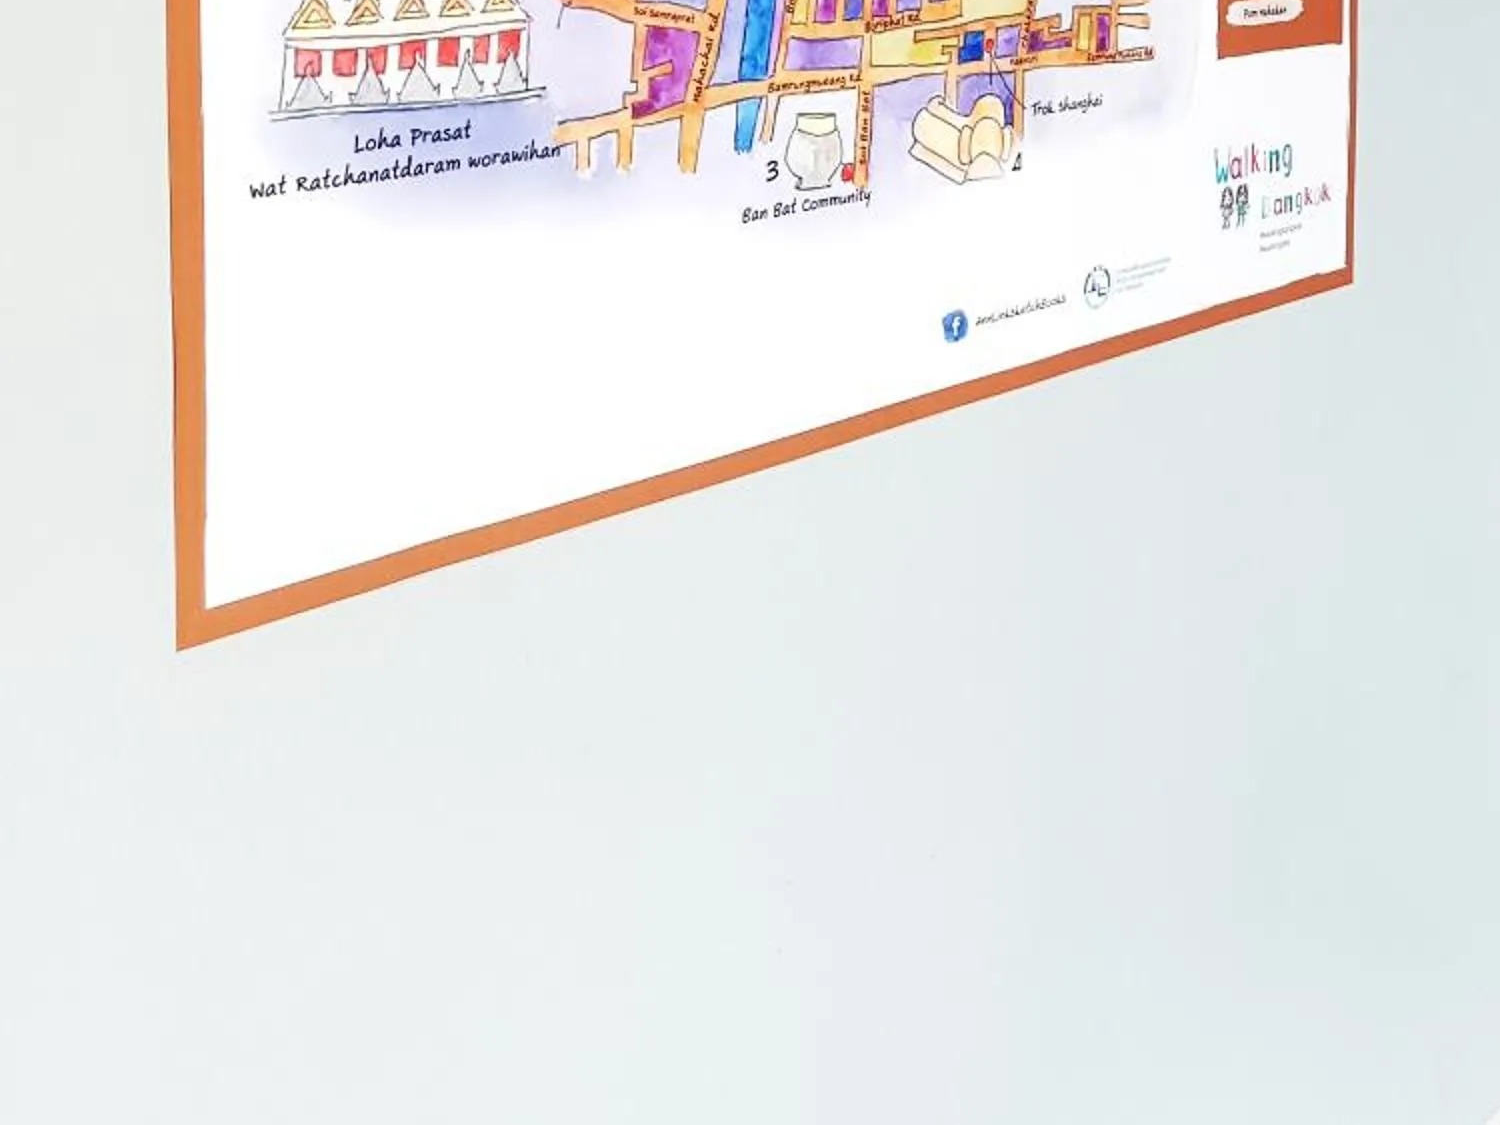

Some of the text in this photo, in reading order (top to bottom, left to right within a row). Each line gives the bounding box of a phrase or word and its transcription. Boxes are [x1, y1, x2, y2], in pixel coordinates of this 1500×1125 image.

[1031, 100, 1055, 116] Trok
[353, 118, 472, 155] Loha Prasat
[249, 176, 287, 199] Wat
[297, 155, 461, 193] Ratchanatdaram
[766, 160, 779, 182] 3
[1012, 152, 1022, 171] 4
[1214, 142, 1293, 184] Walking
[742, 189, 872, 224] Ban Bat Community
